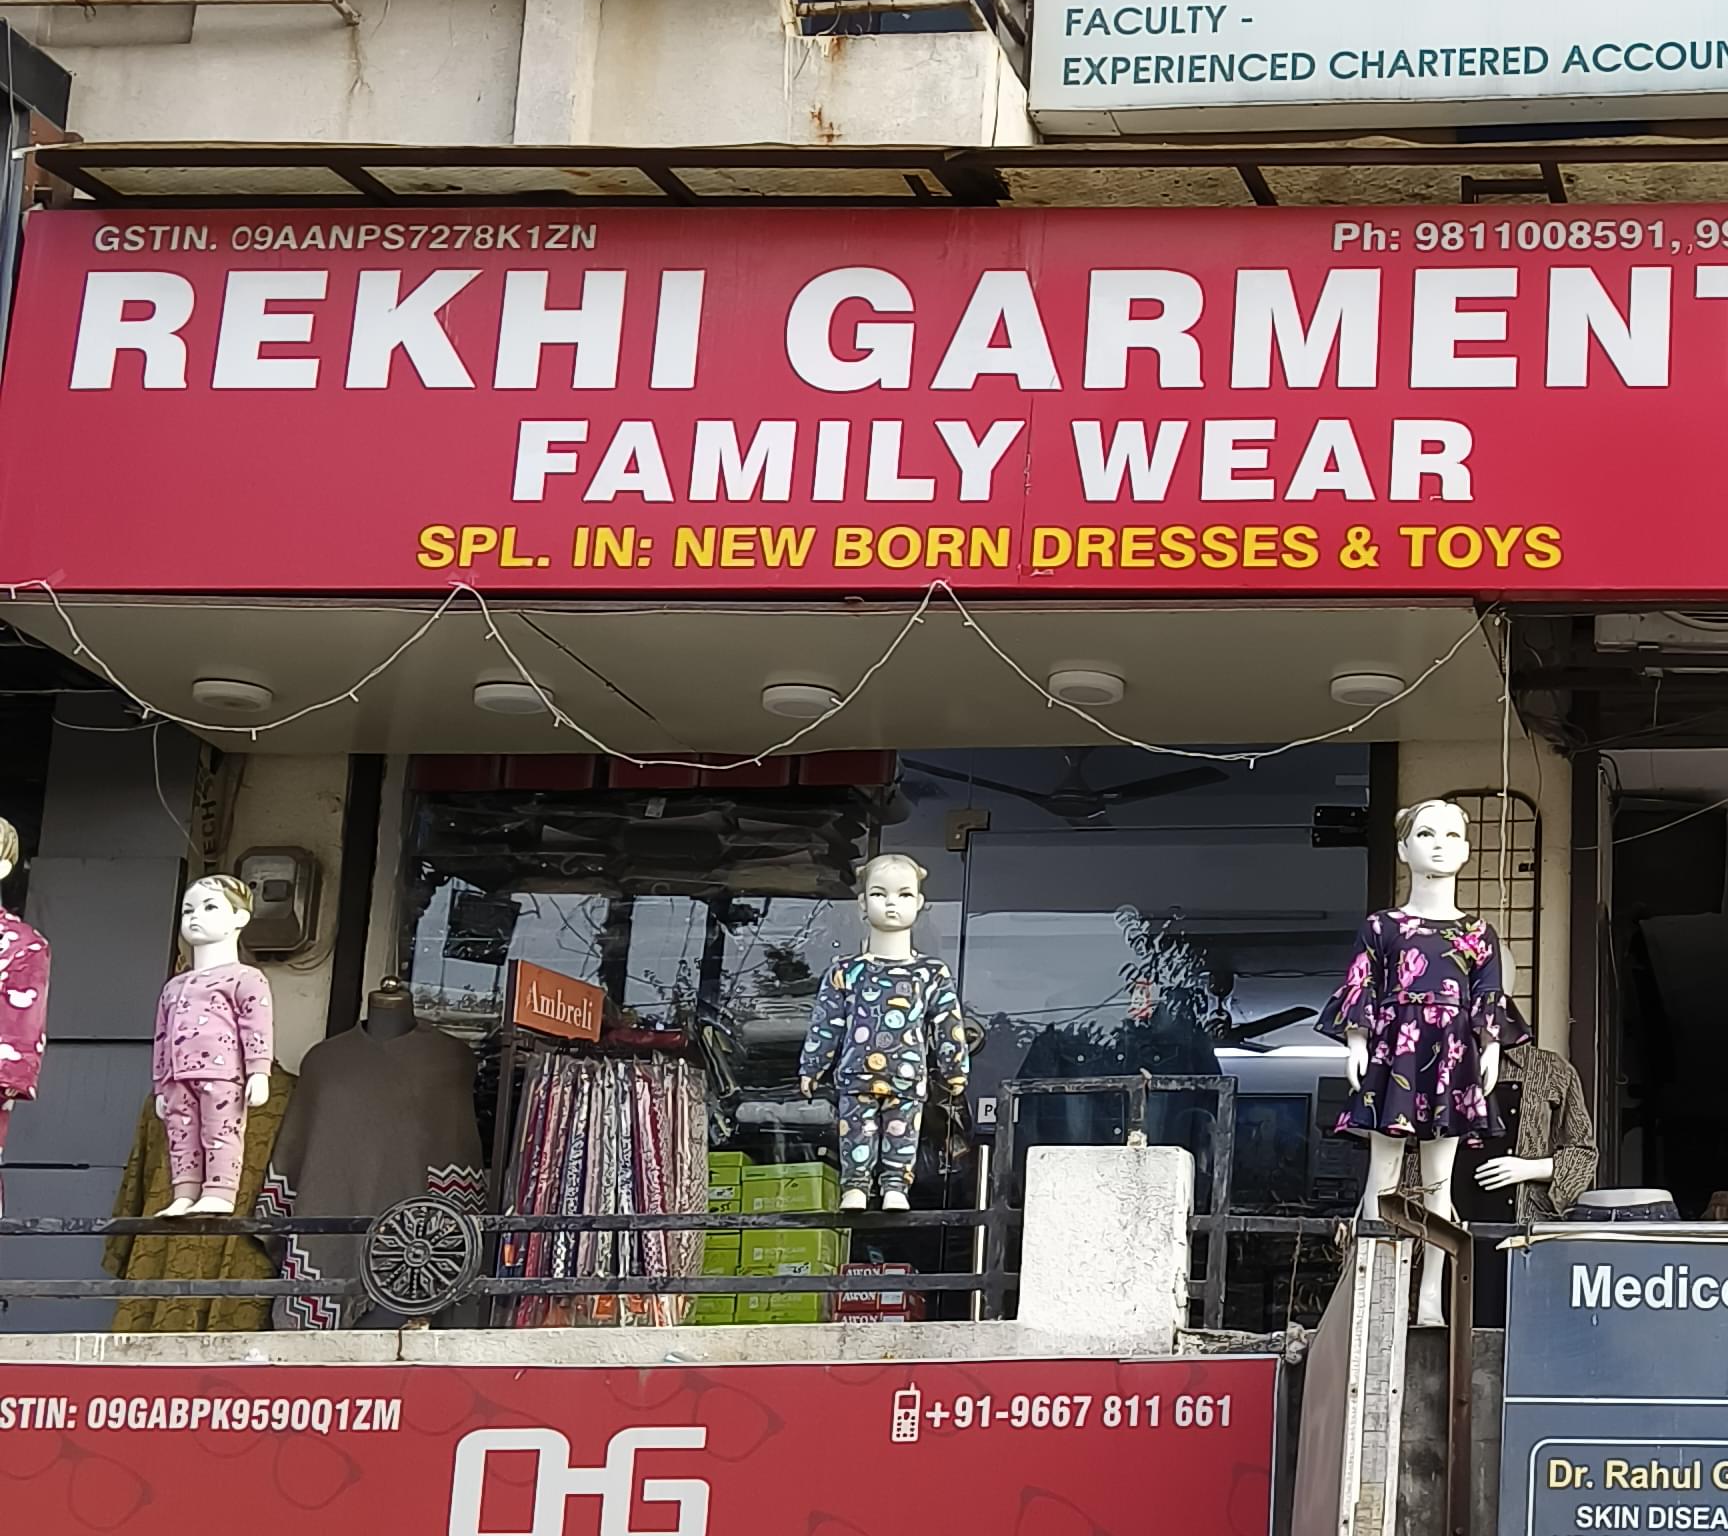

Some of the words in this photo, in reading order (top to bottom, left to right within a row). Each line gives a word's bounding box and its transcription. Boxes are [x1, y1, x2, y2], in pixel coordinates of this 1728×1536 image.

[1066, 5, 1227, 36] FACULTY
[1064, 53, 1315, 85] EXPERIENCED
[1330, 47, 1548, 79] CHARTERED
[96, 226, 216, 251] GSTIN.
[232, 225, 596, 250] 09AANPS7278K1ZN
[1334, 223, 1399, 250] Ph:
[1416, 221, 1680, 254] 9811008591,
[69, 266, 705, 391] REKHI
[513, 421, 1024, 501] FAMILY
[1072, 420, 1473, 500] WEAR
[525, 980, 592, 1031] Ambreli
[88, 1398, 401, 1434] 09GABPK9590Q1ZM
[926, 1396, 1091, 1427] +91-9667
[1104, 1395, 1165, 1426] 811
[1176, 1395, 1230, 1426] 661
[1550, 1460, 1598, 1488] Dr.
[1606, 1460, 1700, 1488] Rahul
[1577, 1506, 1639, 1528] SKIN
